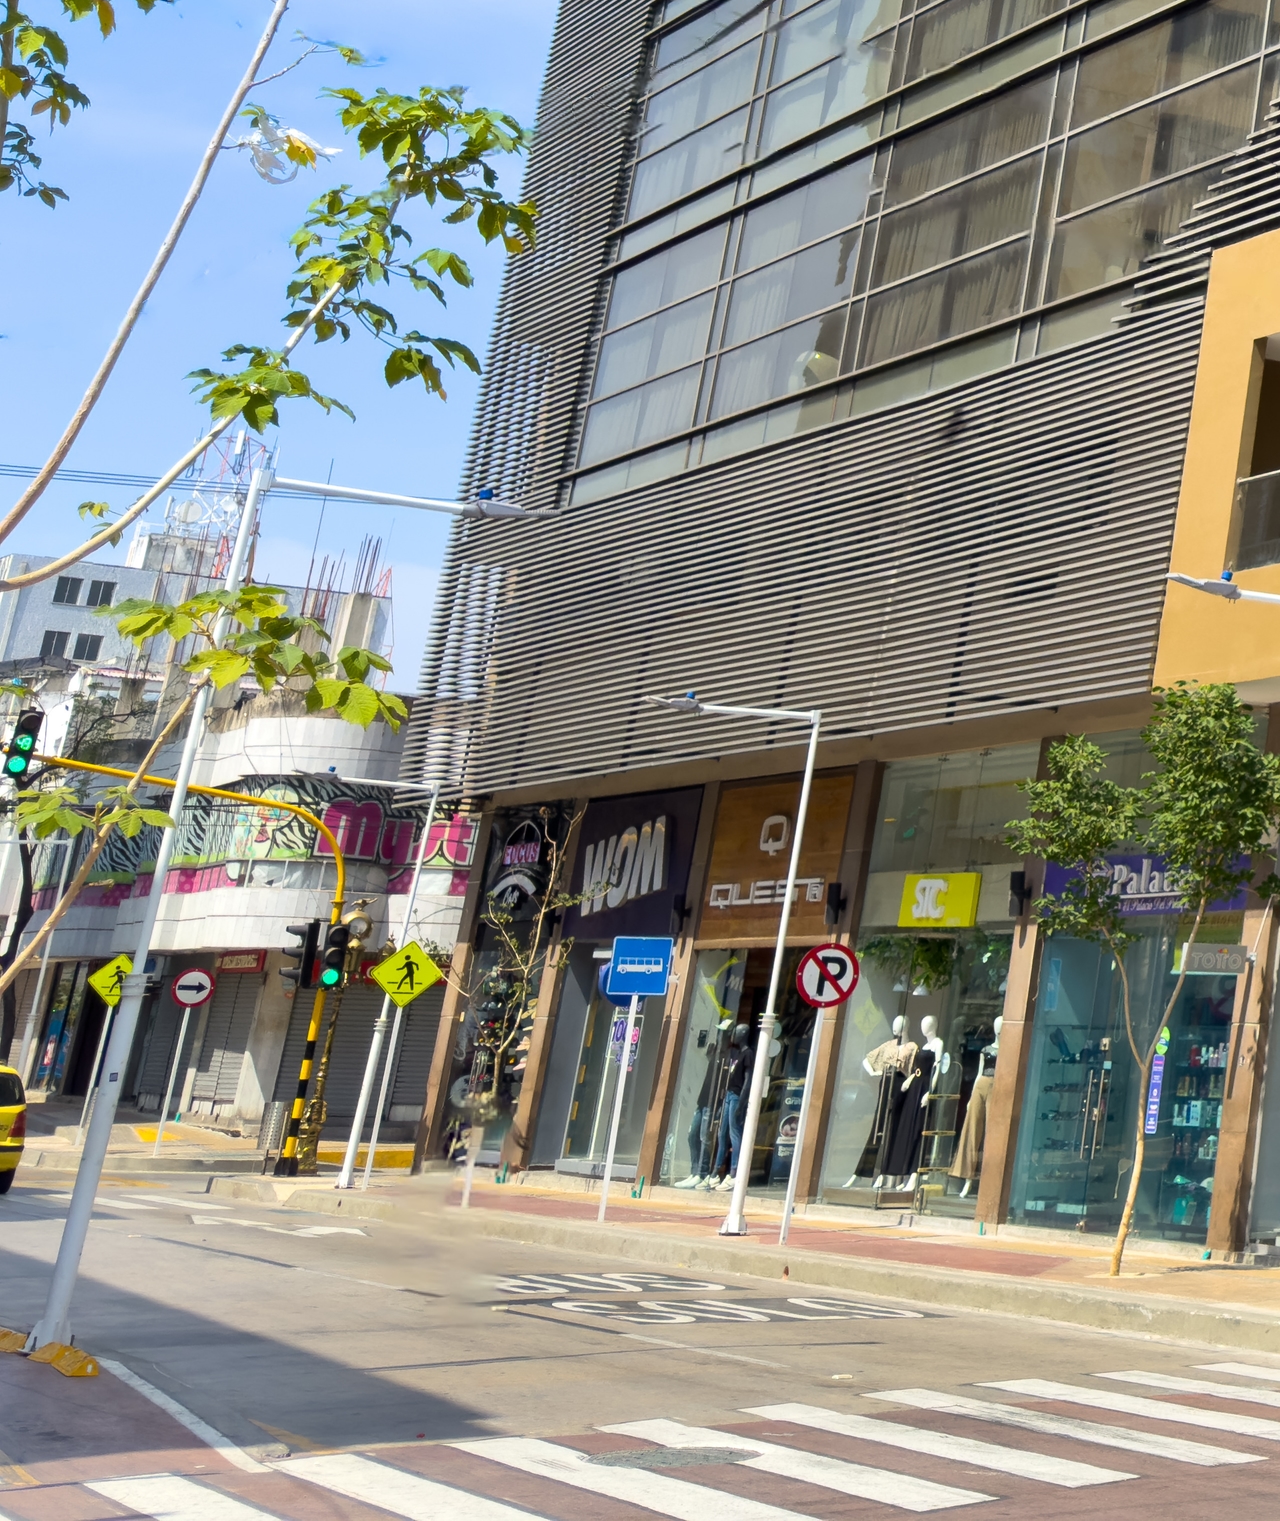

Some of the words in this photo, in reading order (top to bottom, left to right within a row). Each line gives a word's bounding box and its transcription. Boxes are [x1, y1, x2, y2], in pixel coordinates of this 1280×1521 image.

[760, 815, 789, 856] Q
[580, 814, 667, 917] WOM
[815, 955, 848, 997] P
[1191, 952, 1242, 970] TOTTO
